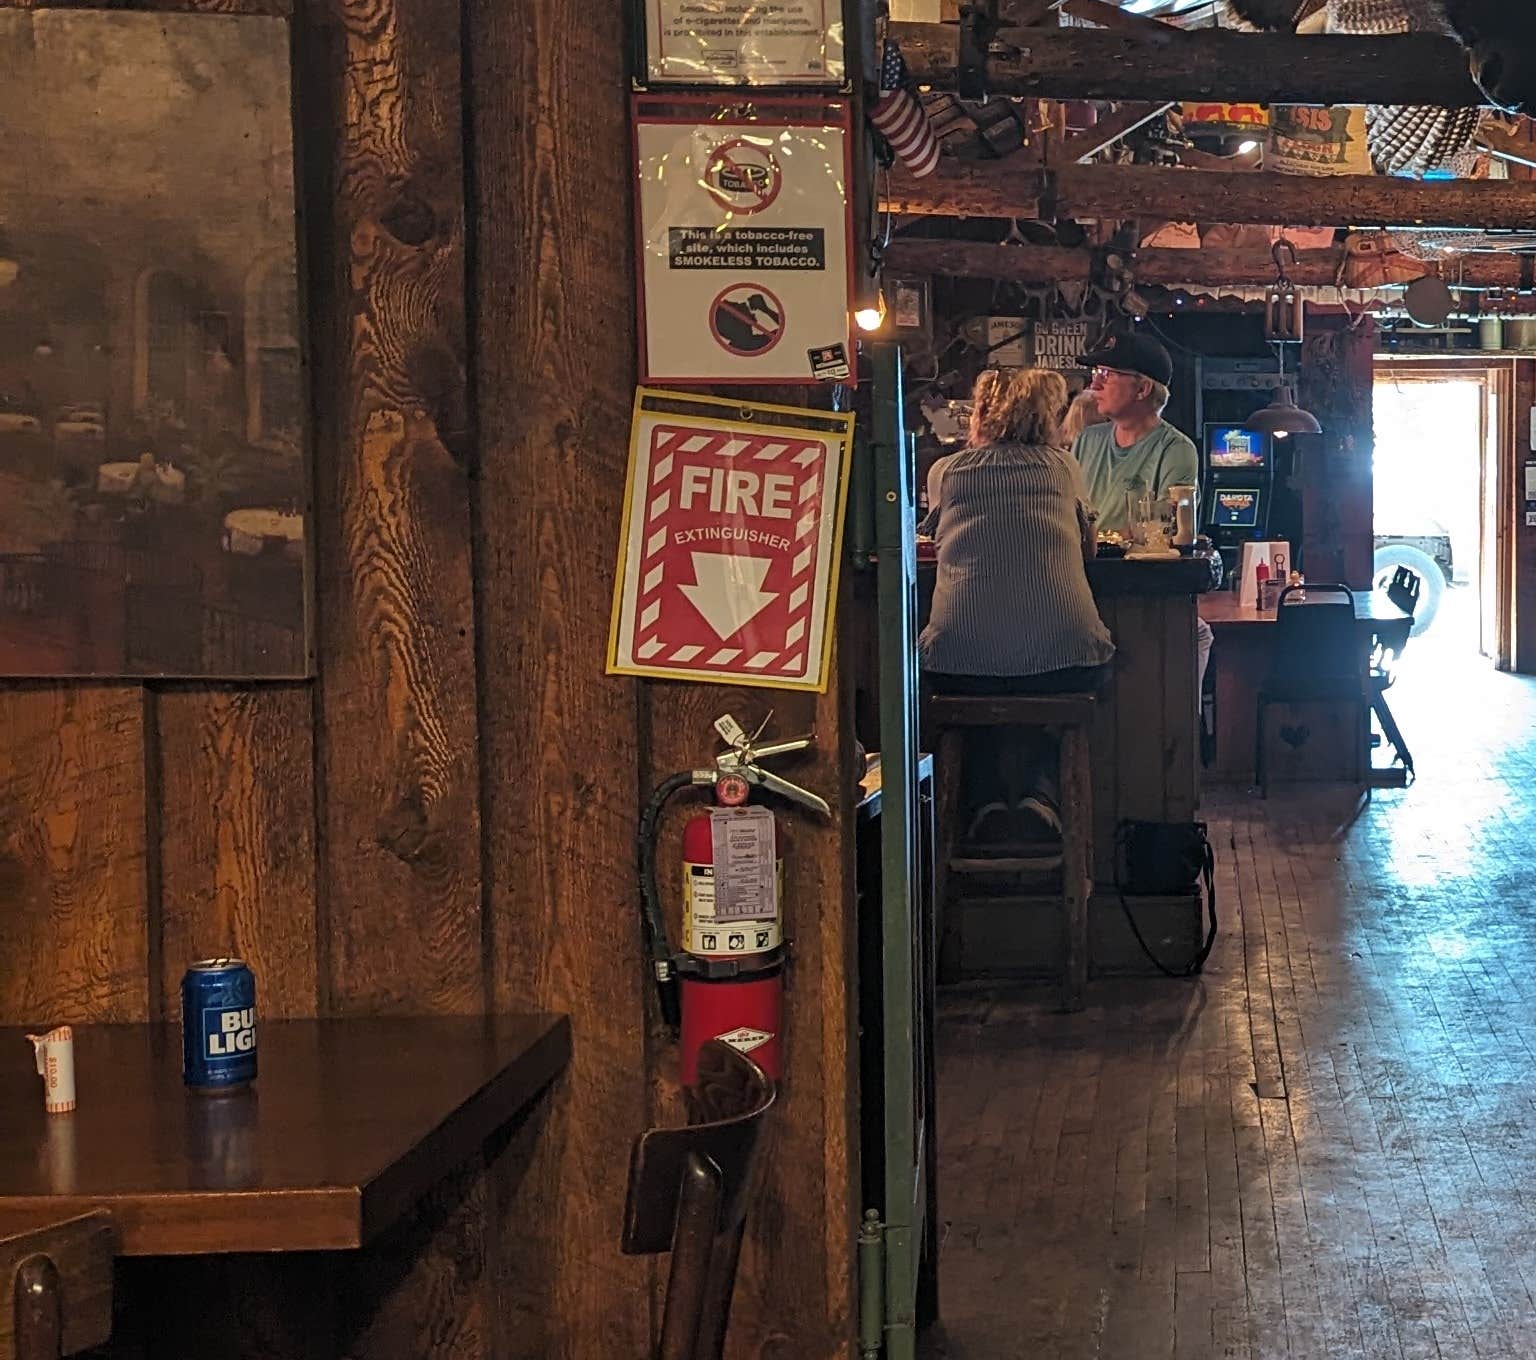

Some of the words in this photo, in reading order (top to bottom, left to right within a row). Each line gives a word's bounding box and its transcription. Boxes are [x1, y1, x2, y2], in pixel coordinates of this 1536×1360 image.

[680, 230, 706, 240] This
[735, 230, 813, 241] tobacco-free
[686, 243, 713, 254] site,
[716, 243, 753, 254] which
[756, 243, 808, 254] includes
[674, 256, 752, 267] SMOKELESS
[755, 256, 820, 267] TOBACCO.
[1051, 322, 1088, 336] GREEN
[1034, 335, 1088, 356] DRINK
[679, 464, 795, 520] FIRE
[674, 526, 791, 552] EXTINGUISHER
